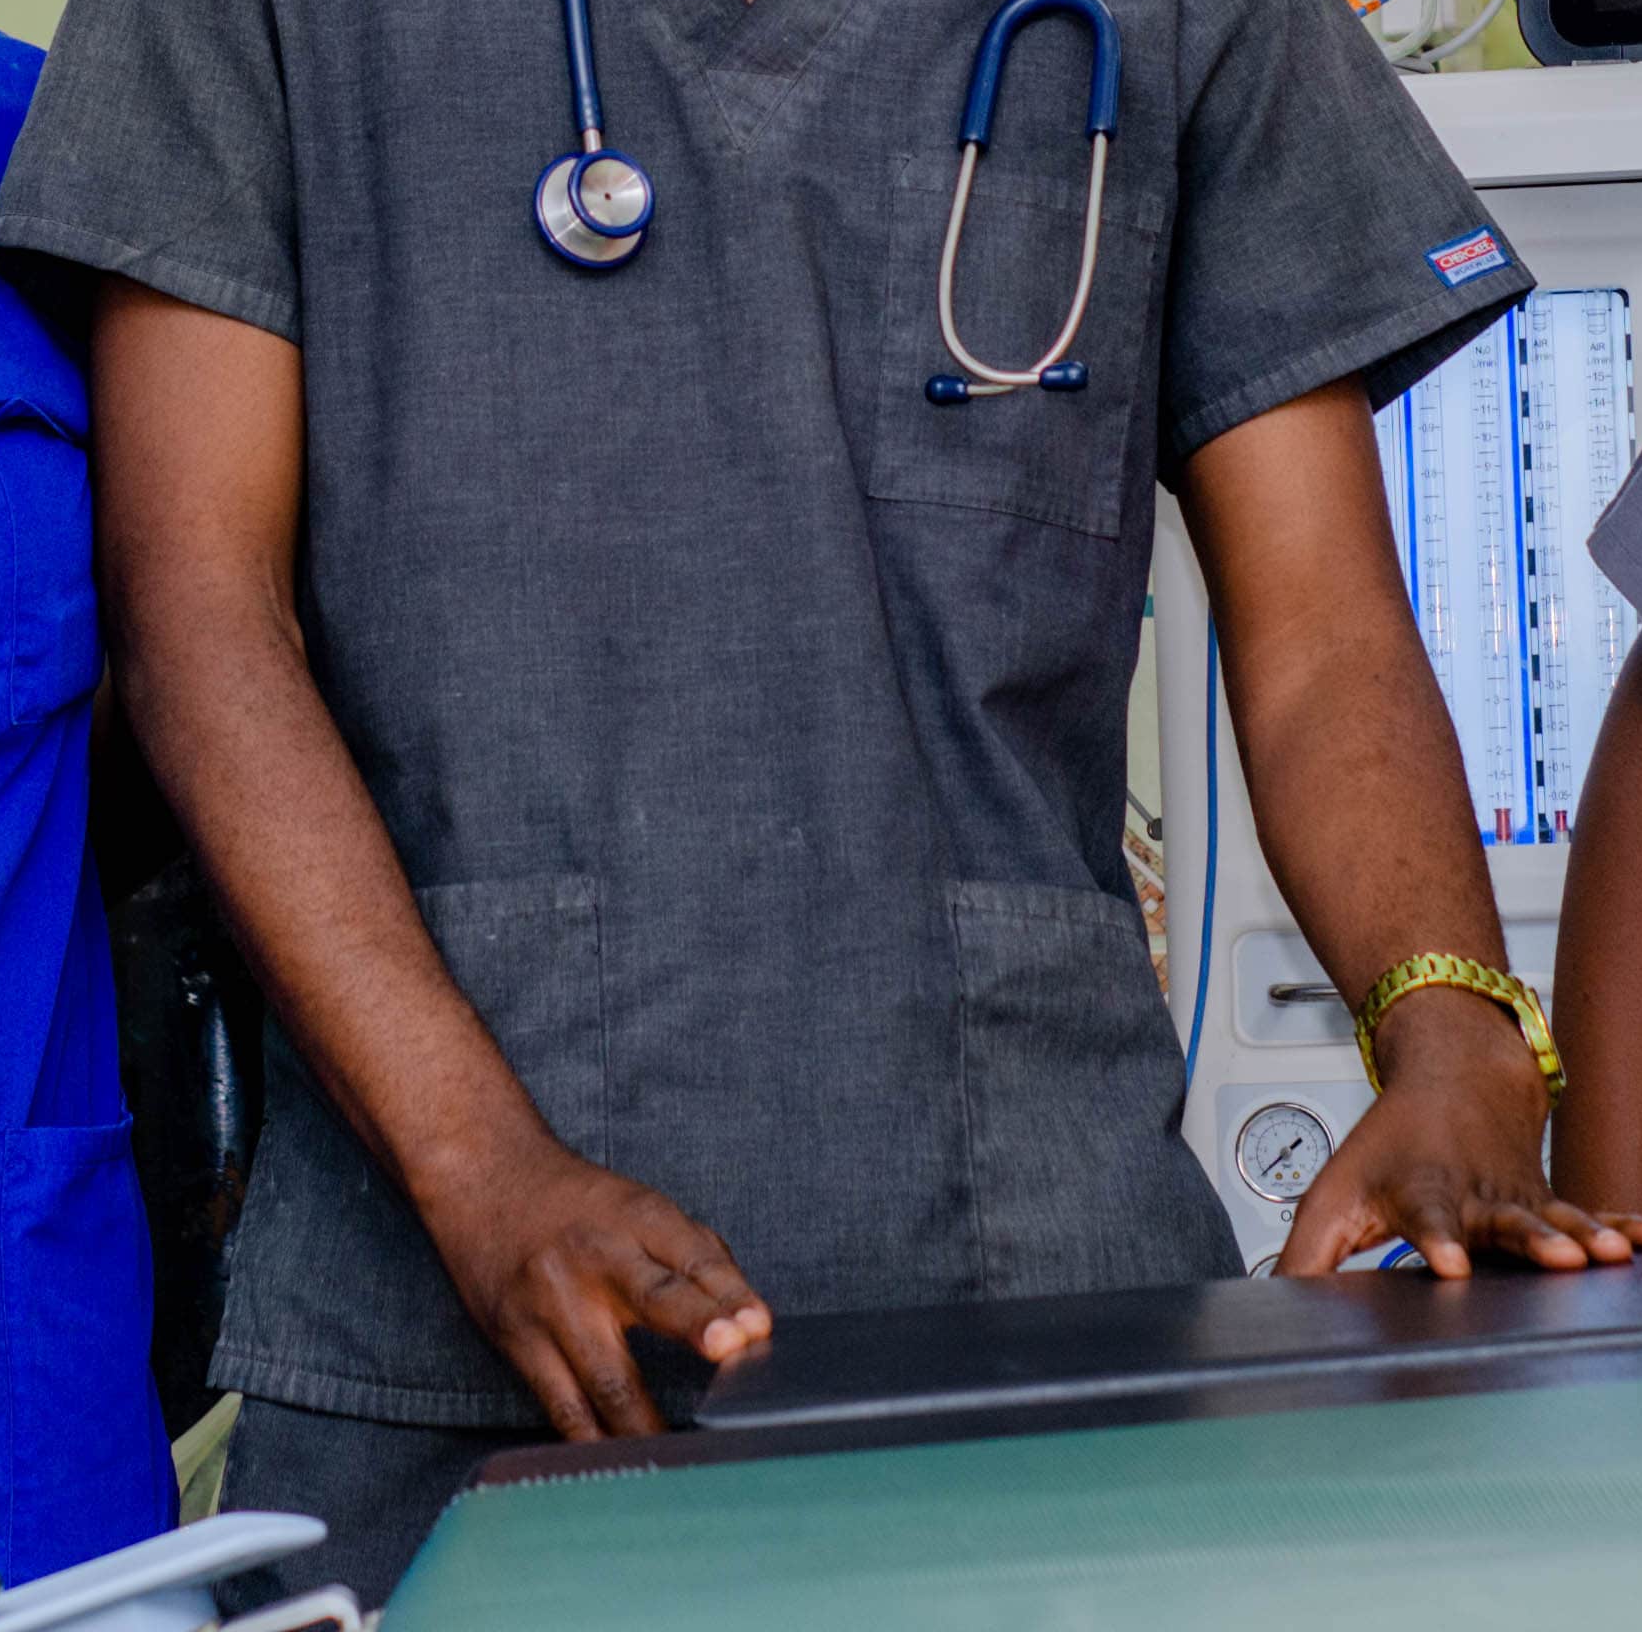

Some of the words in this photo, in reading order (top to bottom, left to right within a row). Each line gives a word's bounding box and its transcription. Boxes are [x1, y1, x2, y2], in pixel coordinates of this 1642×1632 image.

[1589, 342, 1606, 352] AIR
[1592, 371, 1605, 382] 15
[1479, 378, 1492, 389] 12
[1593, 397, 1606, 408] 14
[1480, 403, 1491, 414] 11
